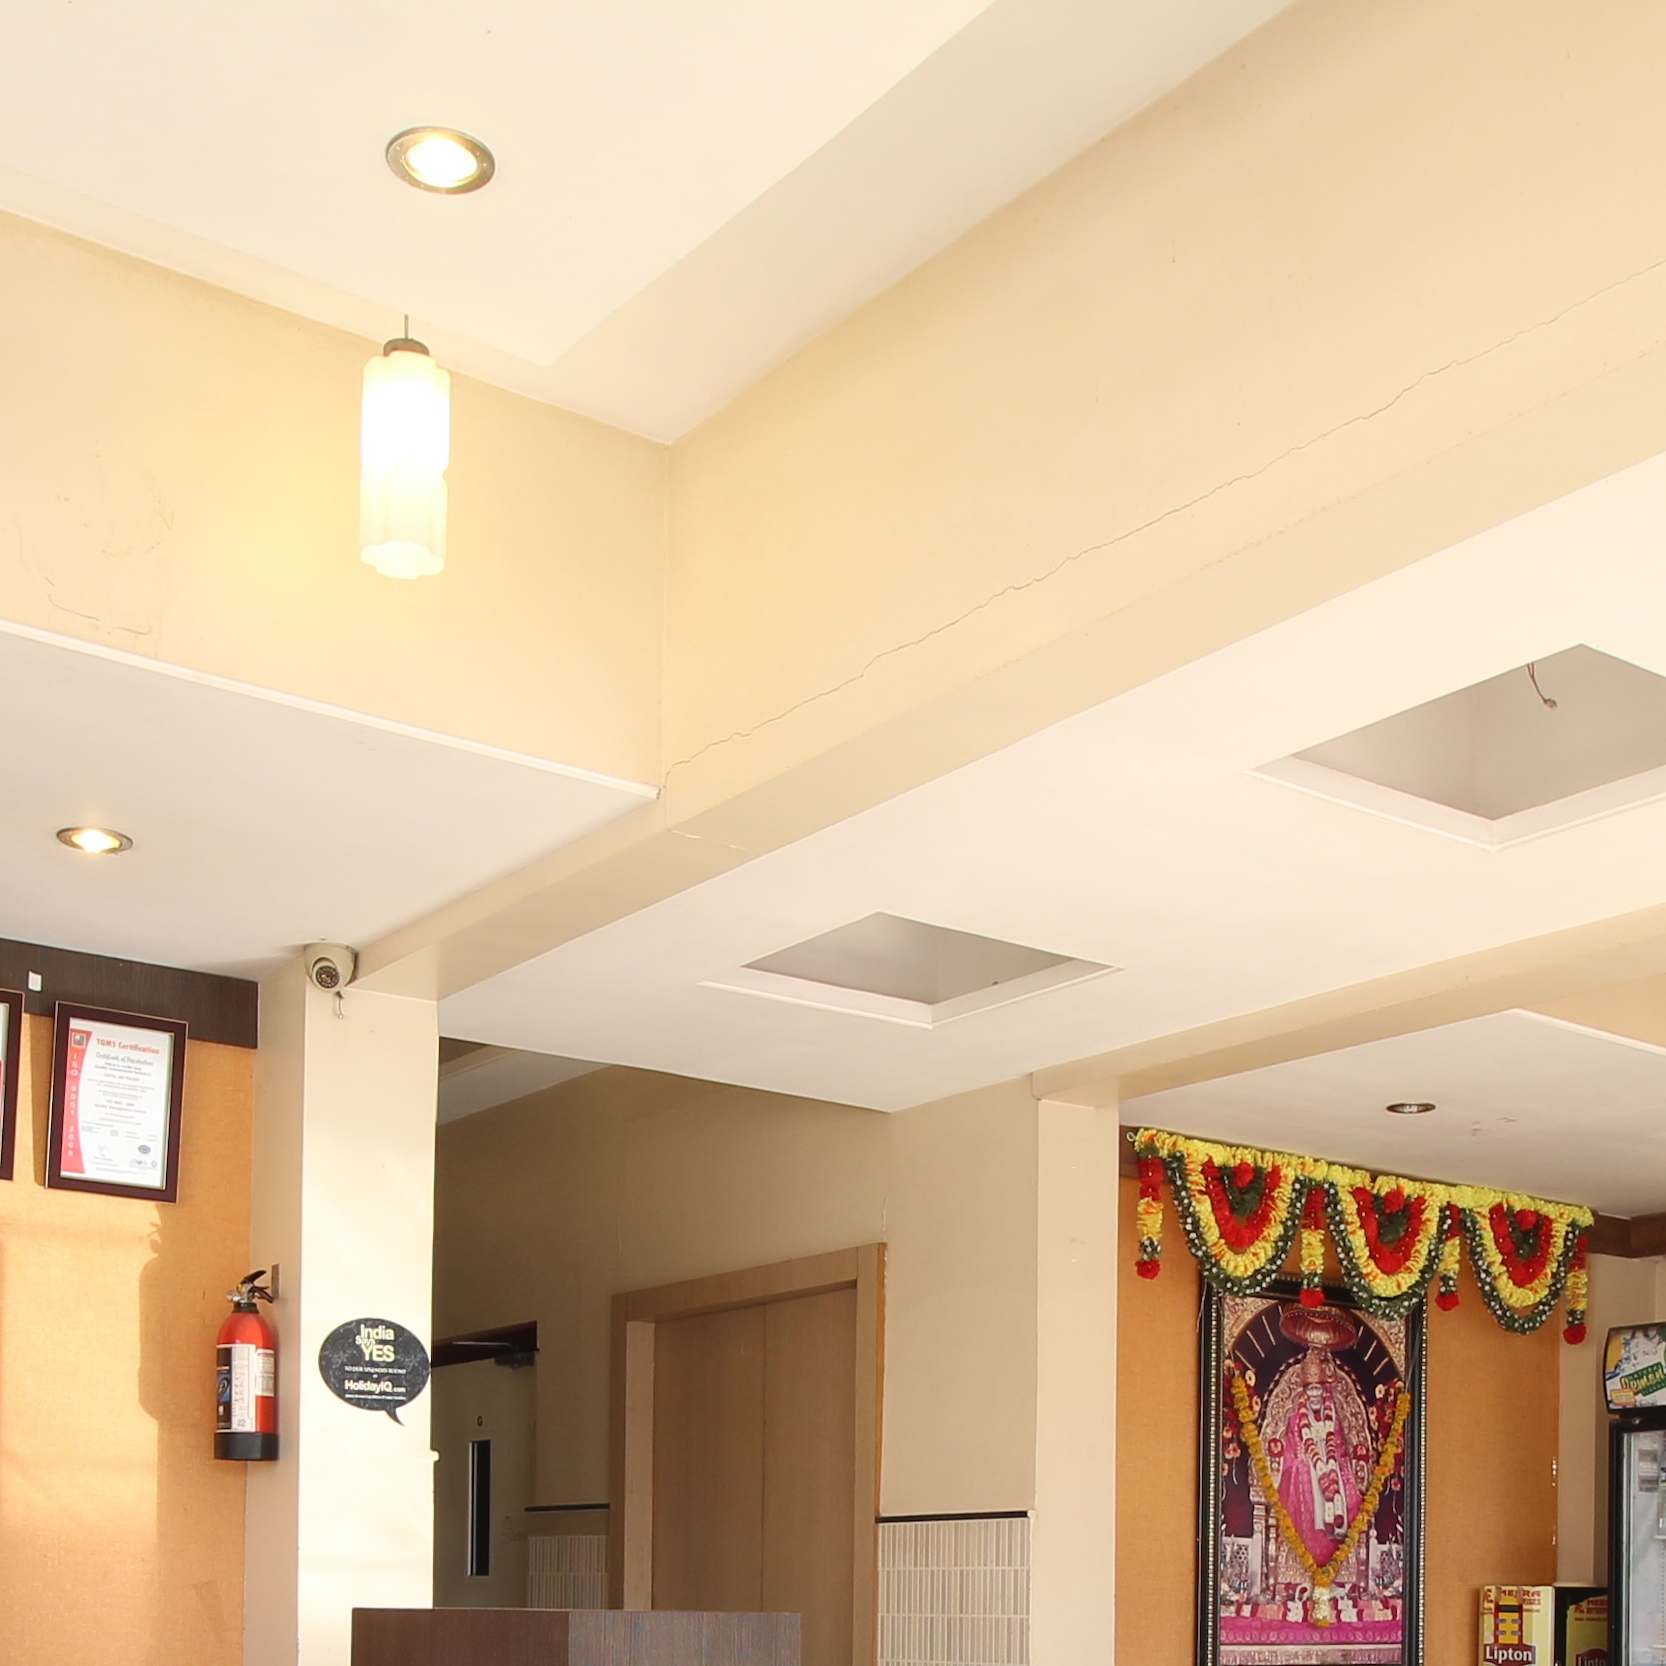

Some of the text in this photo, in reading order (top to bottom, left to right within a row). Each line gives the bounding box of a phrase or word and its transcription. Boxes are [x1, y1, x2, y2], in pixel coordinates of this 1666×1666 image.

[360, 1323, 395, 1341] India
[360, 1344, 395, 1363] YES
[1485, 1645, 1533, 1664] Lipton
